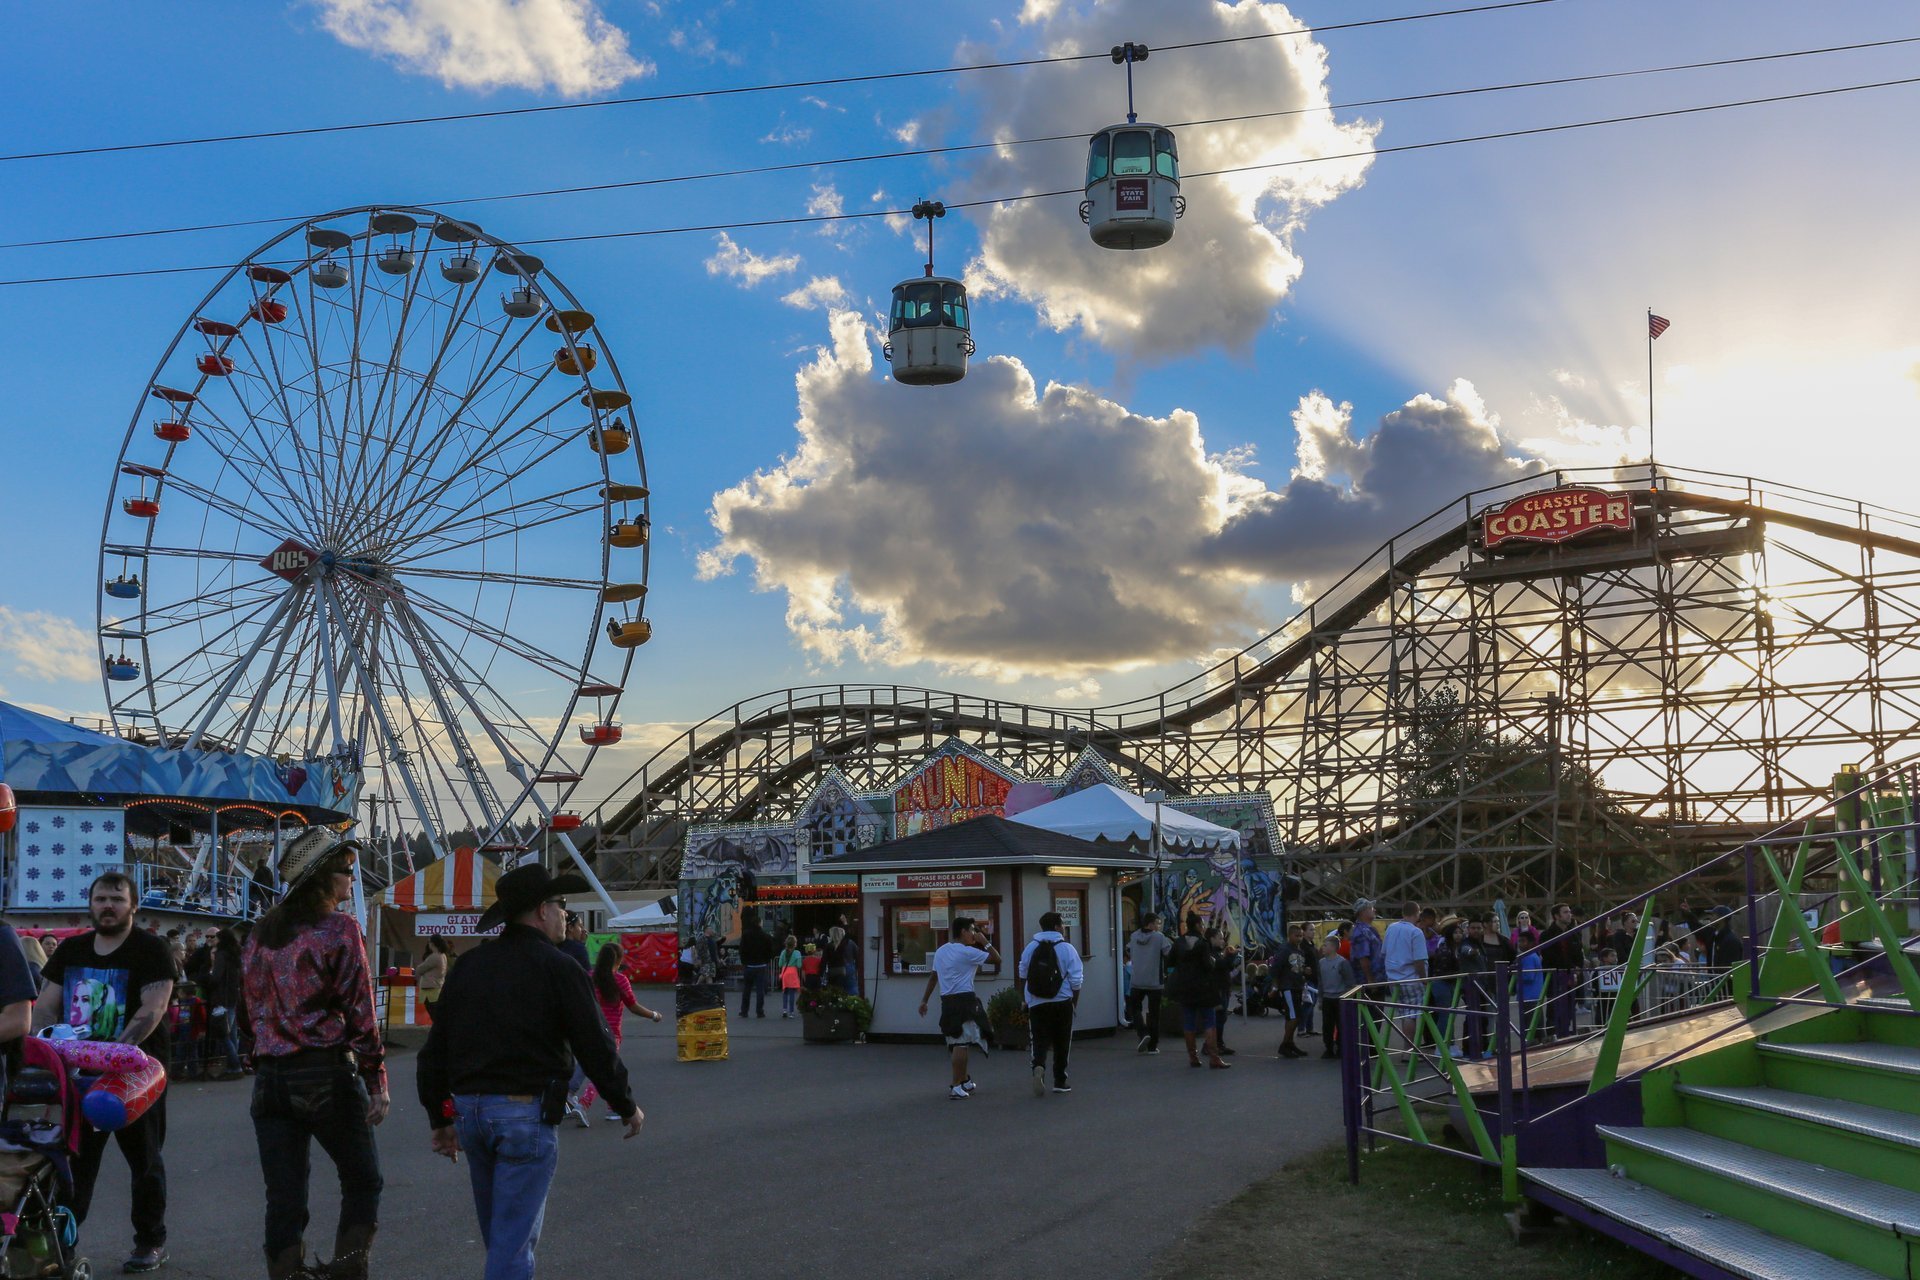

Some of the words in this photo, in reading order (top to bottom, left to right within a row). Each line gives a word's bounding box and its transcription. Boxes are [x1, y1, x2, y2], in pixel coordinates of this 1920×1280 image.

[1523, 494, 1589, 512] CLASSIC
[1489, 502, 1626, 536] COASTER
[447, 915, 480, 924] GIAN
[418, 925, 456, 935] PHOTO
